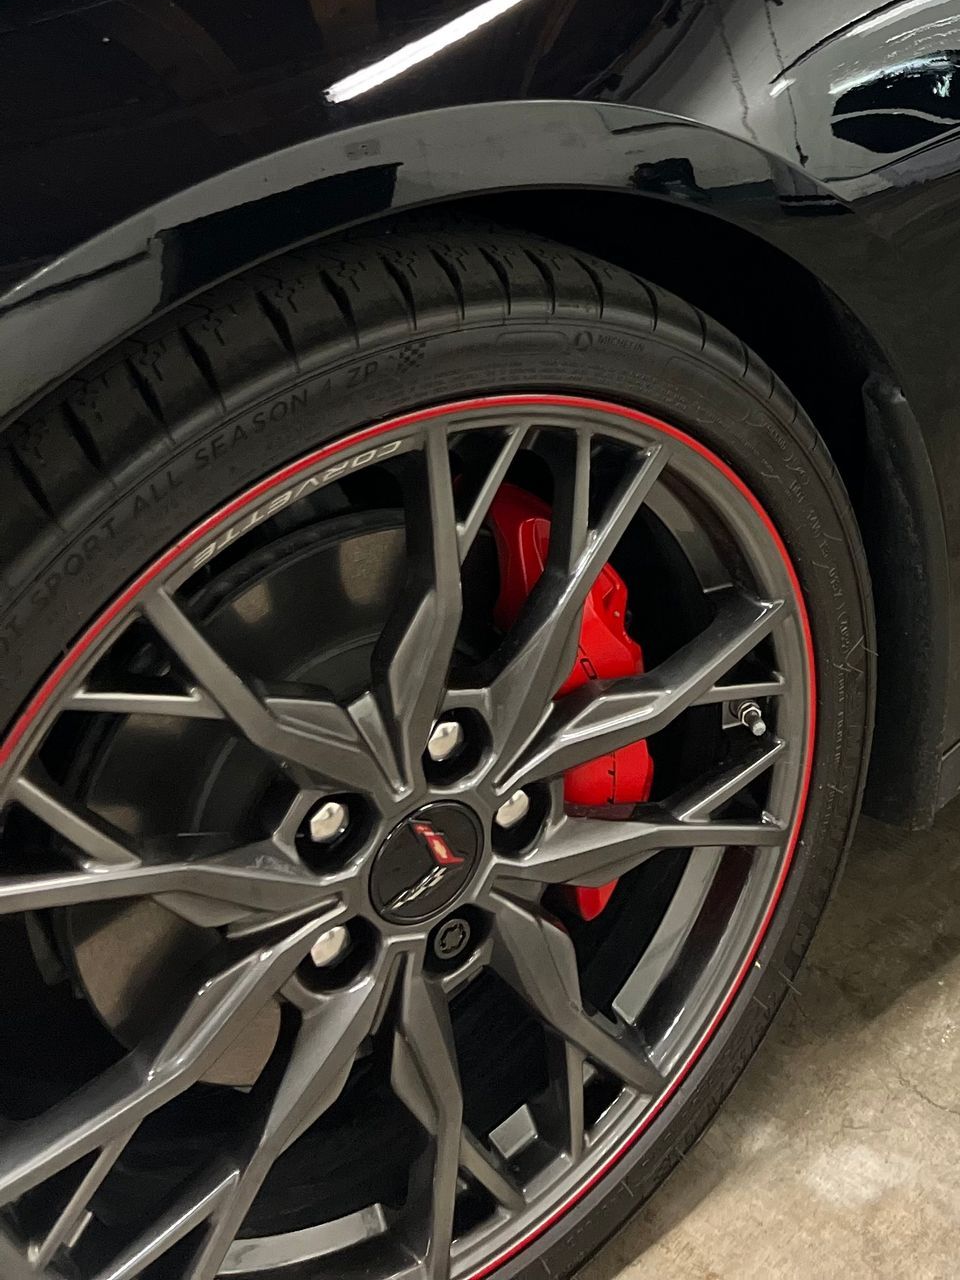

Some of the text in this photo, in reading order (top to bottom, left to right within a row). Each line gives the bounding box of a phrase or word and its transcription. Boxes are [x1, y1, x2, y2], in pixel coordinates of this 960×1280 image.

[31, 516, 120, 611] SPORT
[133, 470, 184, 515] ALL
[192, 387, 309, 469] SEASON
[192, 439, 403, 570] CORVETTE
